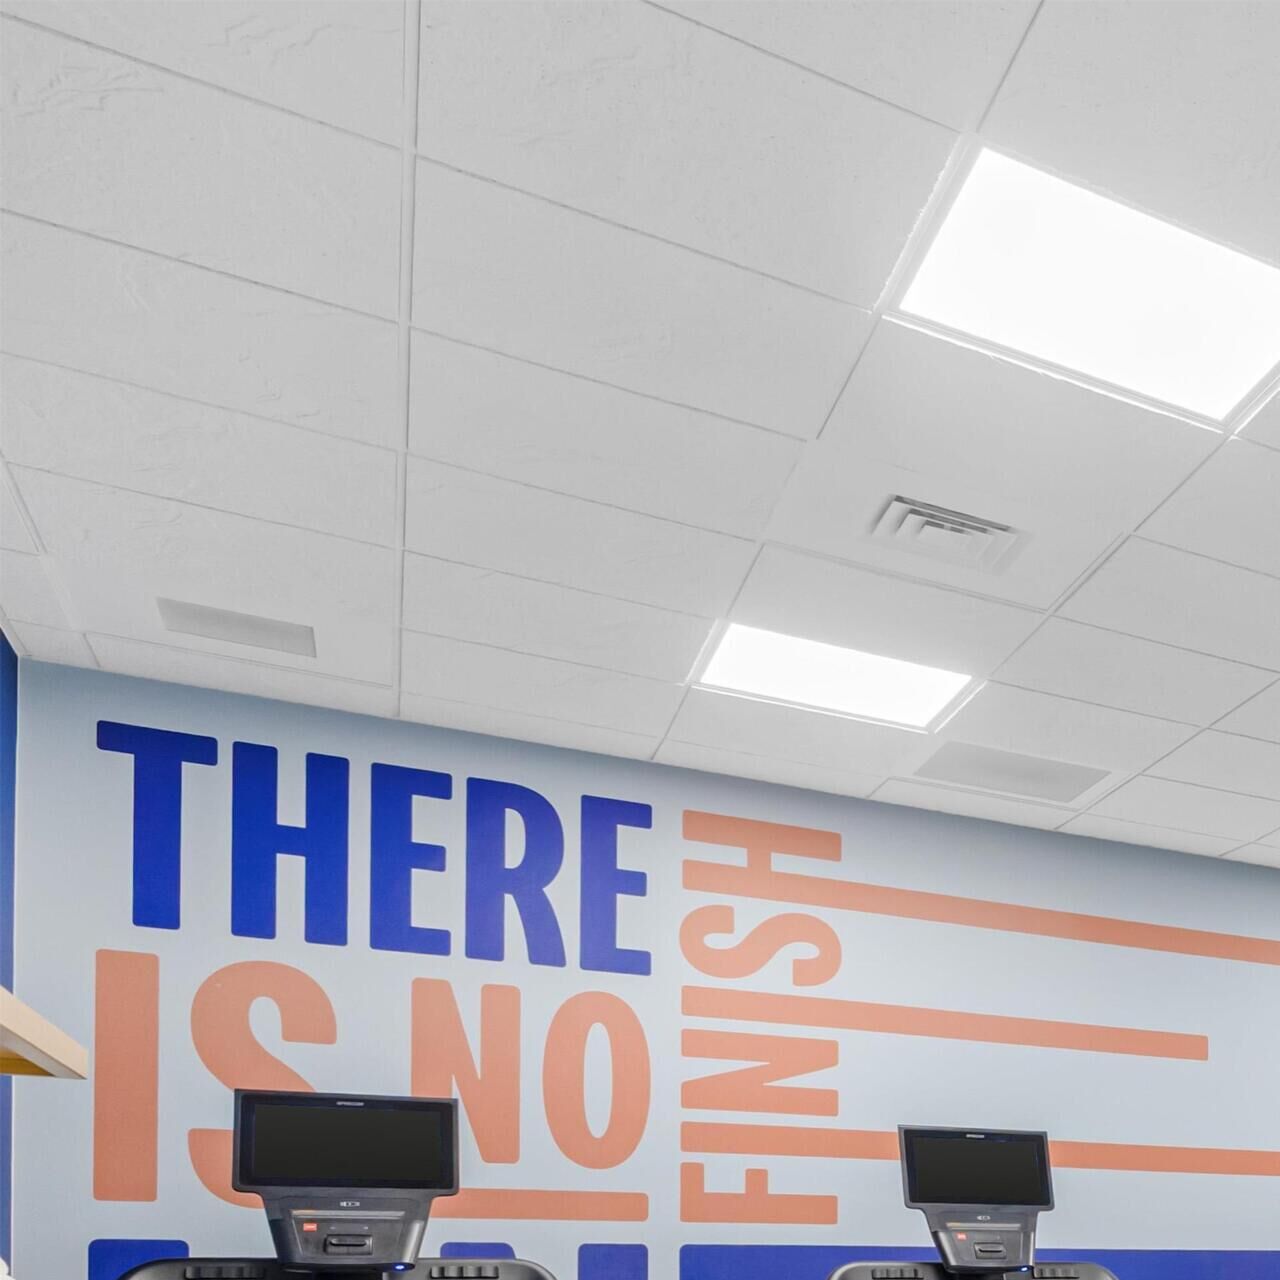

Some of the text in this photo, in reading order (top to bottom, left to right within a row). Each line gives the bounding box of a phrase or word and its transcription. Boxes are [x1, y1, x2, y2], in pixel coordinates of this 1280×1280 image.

[96, 720, 653, 976] THERE
[93, 949, 651, 1209] IS NO
[680, 810, 842, 1224] FINISH
